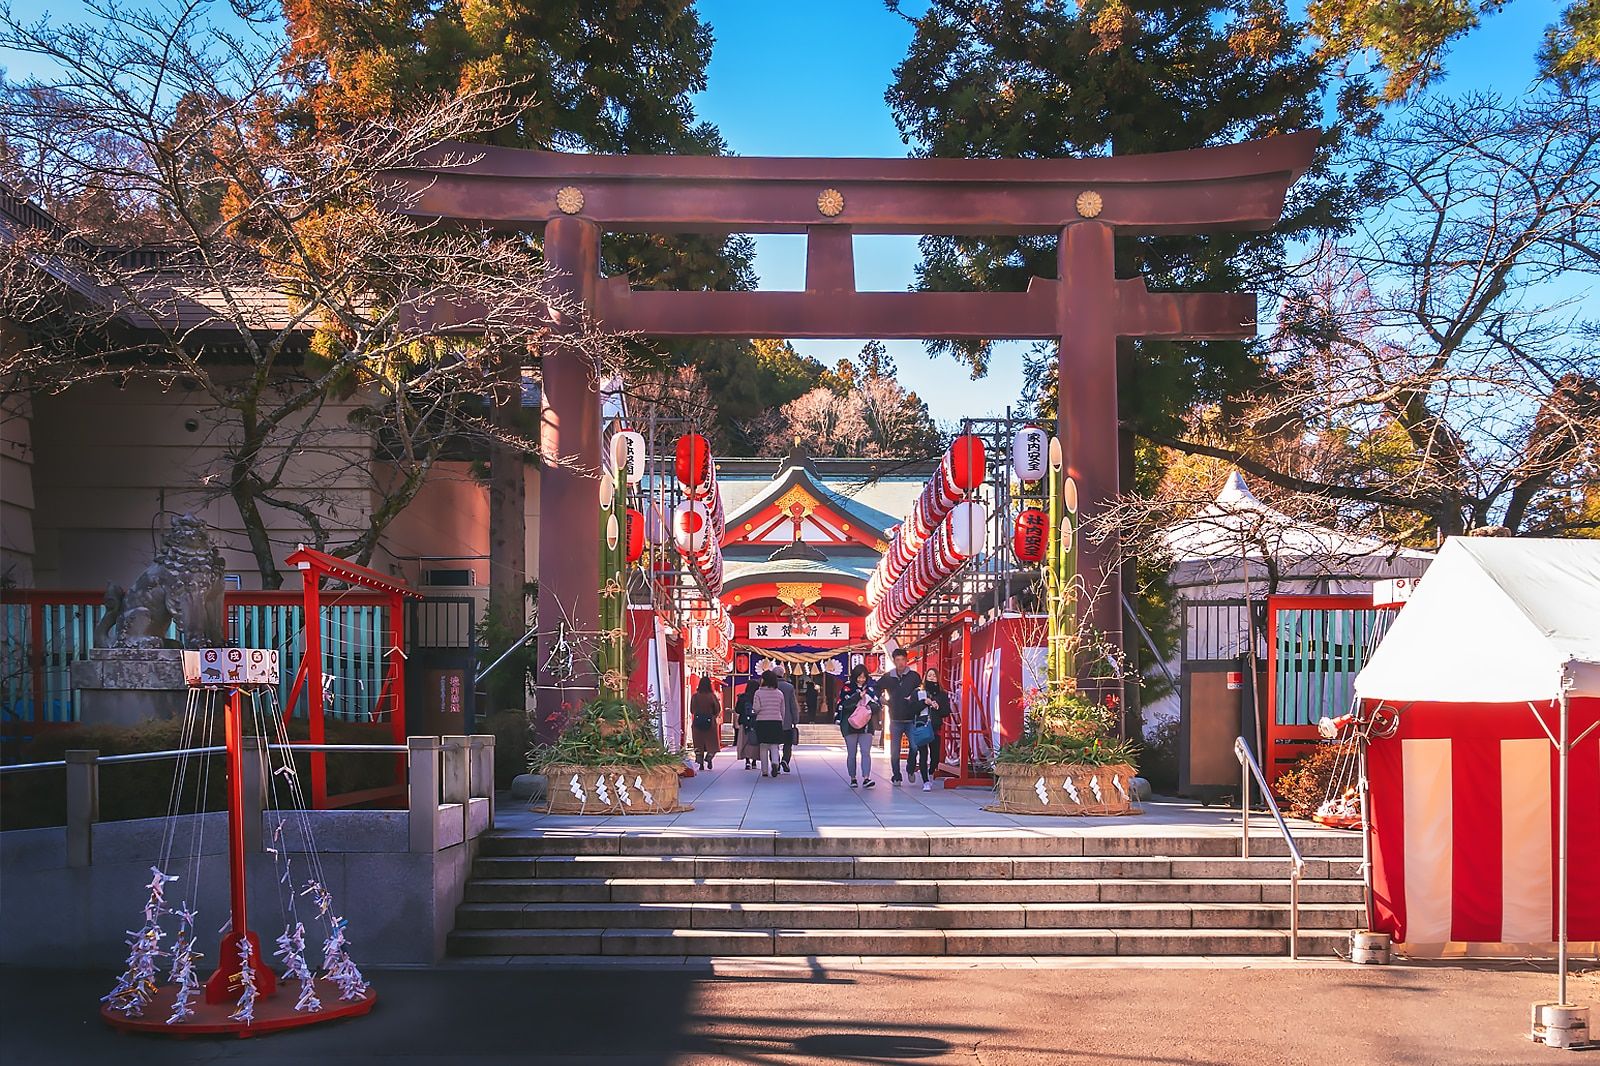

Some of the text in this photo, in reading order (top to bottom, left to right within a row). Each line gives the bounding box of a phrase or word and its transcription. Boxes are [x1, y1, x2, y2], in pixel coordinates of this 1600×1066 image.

[1027, 432, 1041, 471] 家内安全
[1024, 514, 1044, 556] 社内安全
